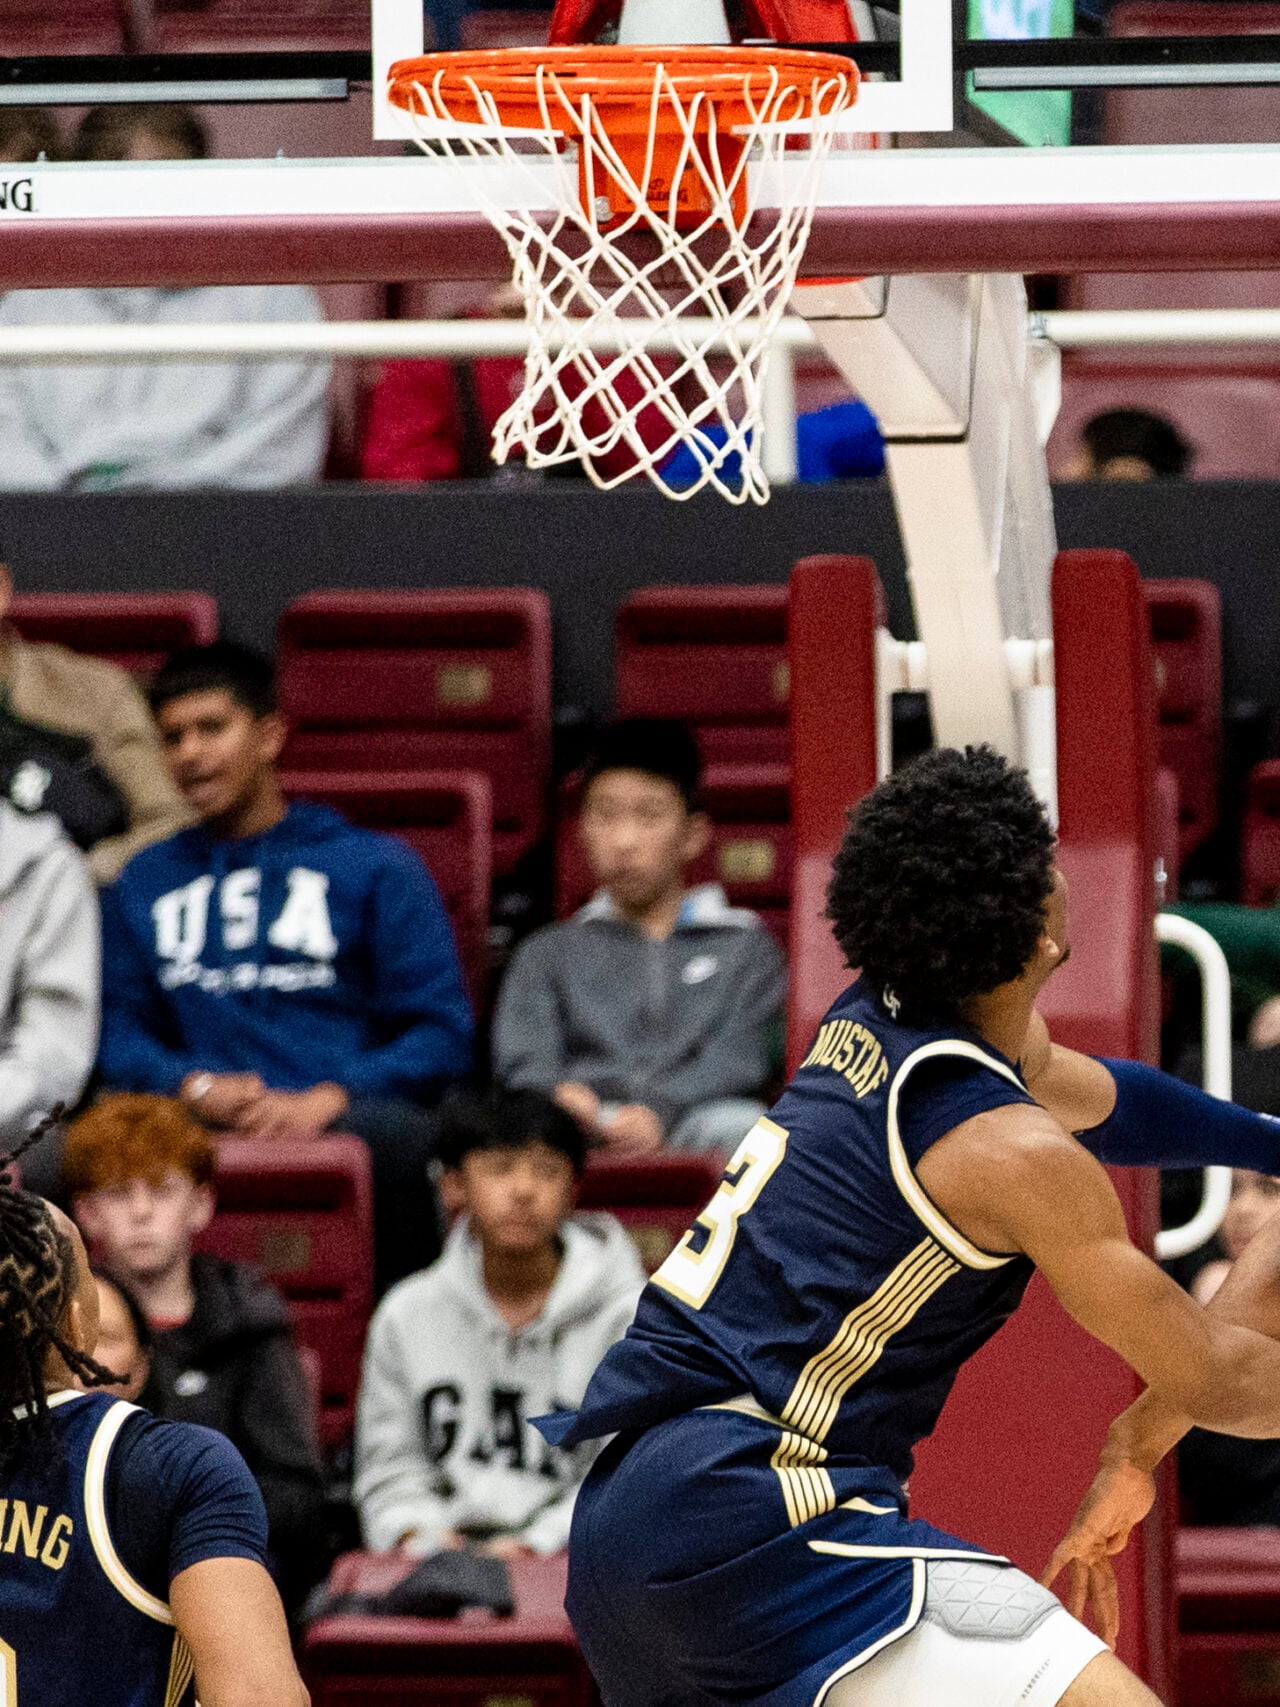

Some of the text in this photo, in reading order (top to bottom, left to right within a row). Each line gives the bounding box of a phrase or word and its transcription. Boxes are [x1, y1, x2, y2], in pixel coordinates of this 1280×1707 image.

[152, 866, 339, 962] USA
[799, 1019, 889, 1099] MUSTAF
[650, 1116, 790, 1311] 3
